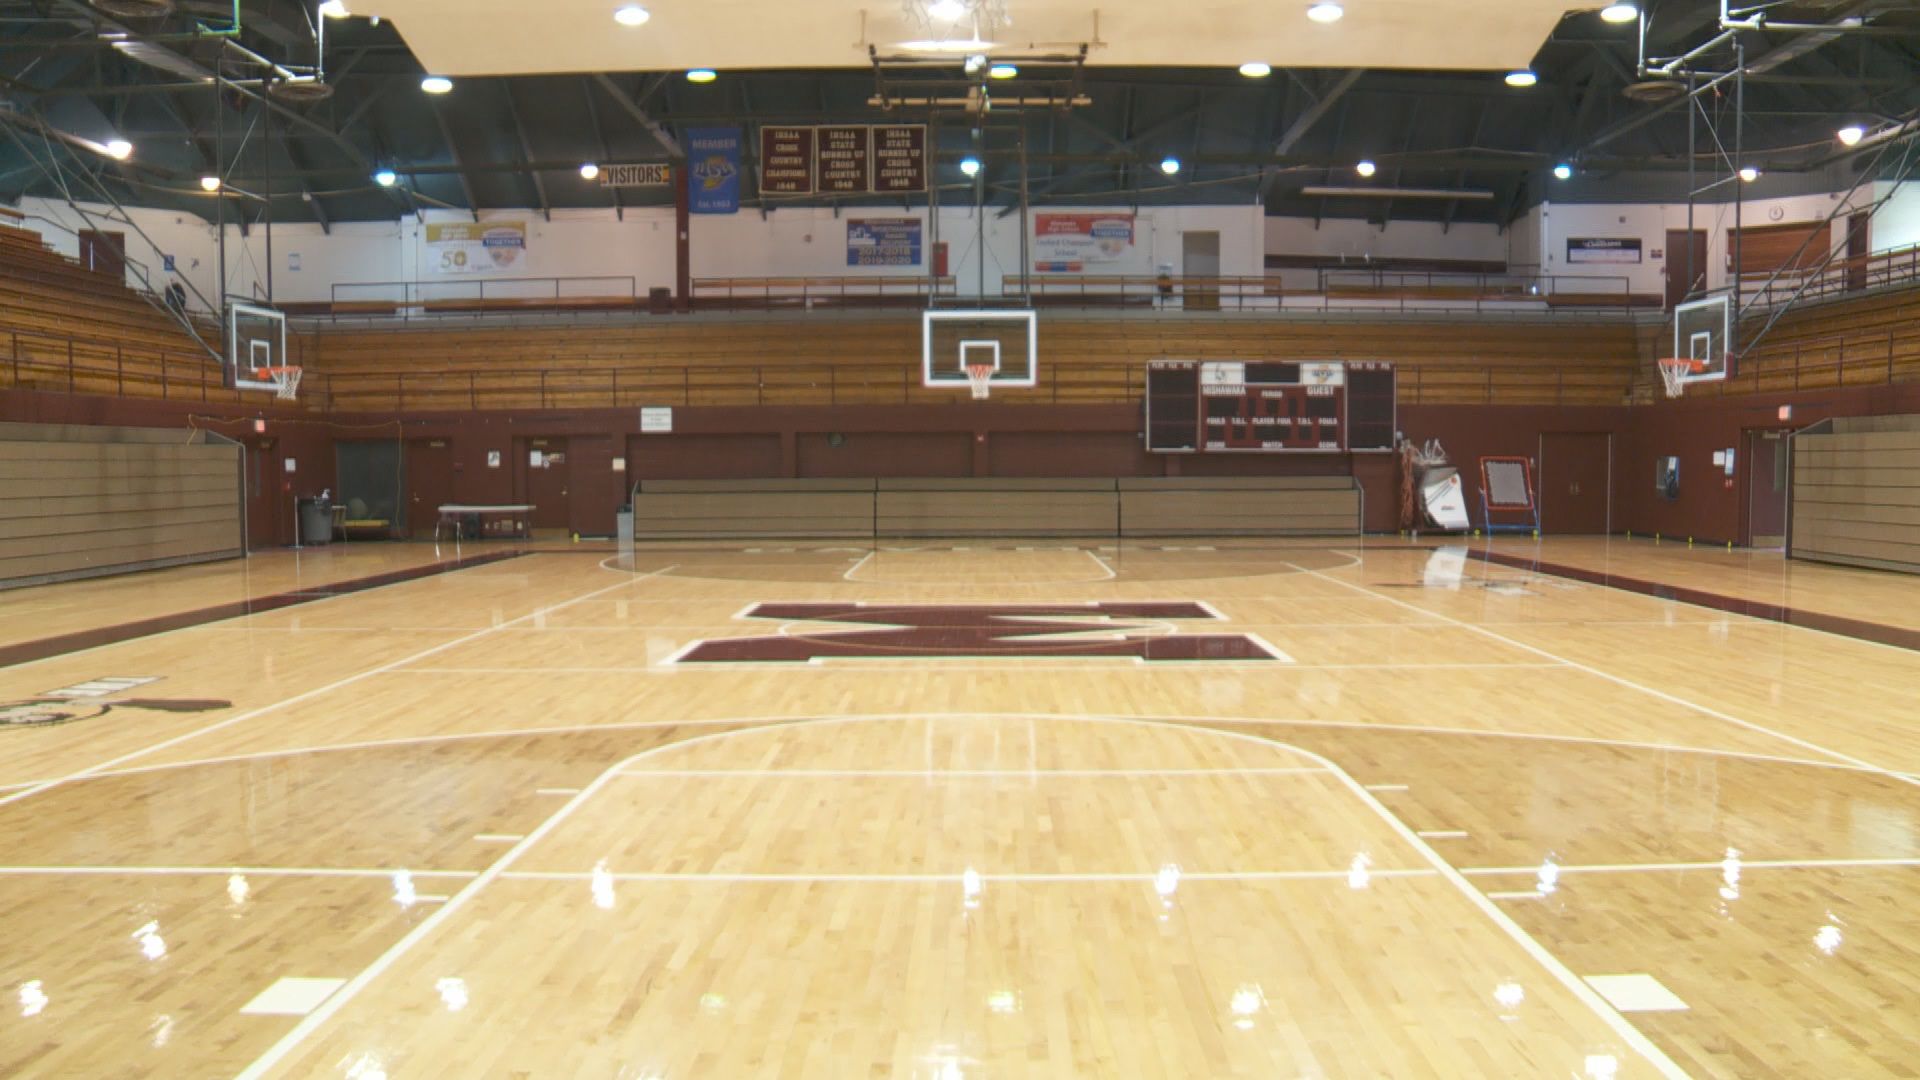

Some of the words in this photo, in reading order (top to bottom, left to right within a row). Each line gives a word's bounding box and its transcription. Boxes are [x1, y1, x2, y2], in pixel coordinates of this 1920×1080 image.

[692, 139, 737, 149] MEMBER
[830, 141, 855, 149] STATE
[886, 139, 911, 148] STATE
[821, 150, 852, 158] RUNNER
[854, 150, 864, 158] UP
[879, 149, 908, 157] RUNNER
[910, 149, 920, 157] UP
[770, 157, 803, 165] COUNTRY
[830, 161, 855, 169] CROSS
[886, 159, 911, 167] CROSS
[607, 165, 662, 184] VISITORS
[766, 169, 806, 177] CHAMPIONS
[825, 170, 861, 178] COUNTRY
[881, 168, 917, 177] COUNTRY
[1202, 385, 1247, 396] MISHAWAKA
[1306, 385, 1334, 396] GUEST
[1206, 417, 1226, 425] FOULS
[1252, 417, 1275, 425] PLAYER
[1276, 417, 1292, 425] FOUL
[1318, 417, 1338, 425] FOULS
[1261, 441, 1283, 449] MATCH
